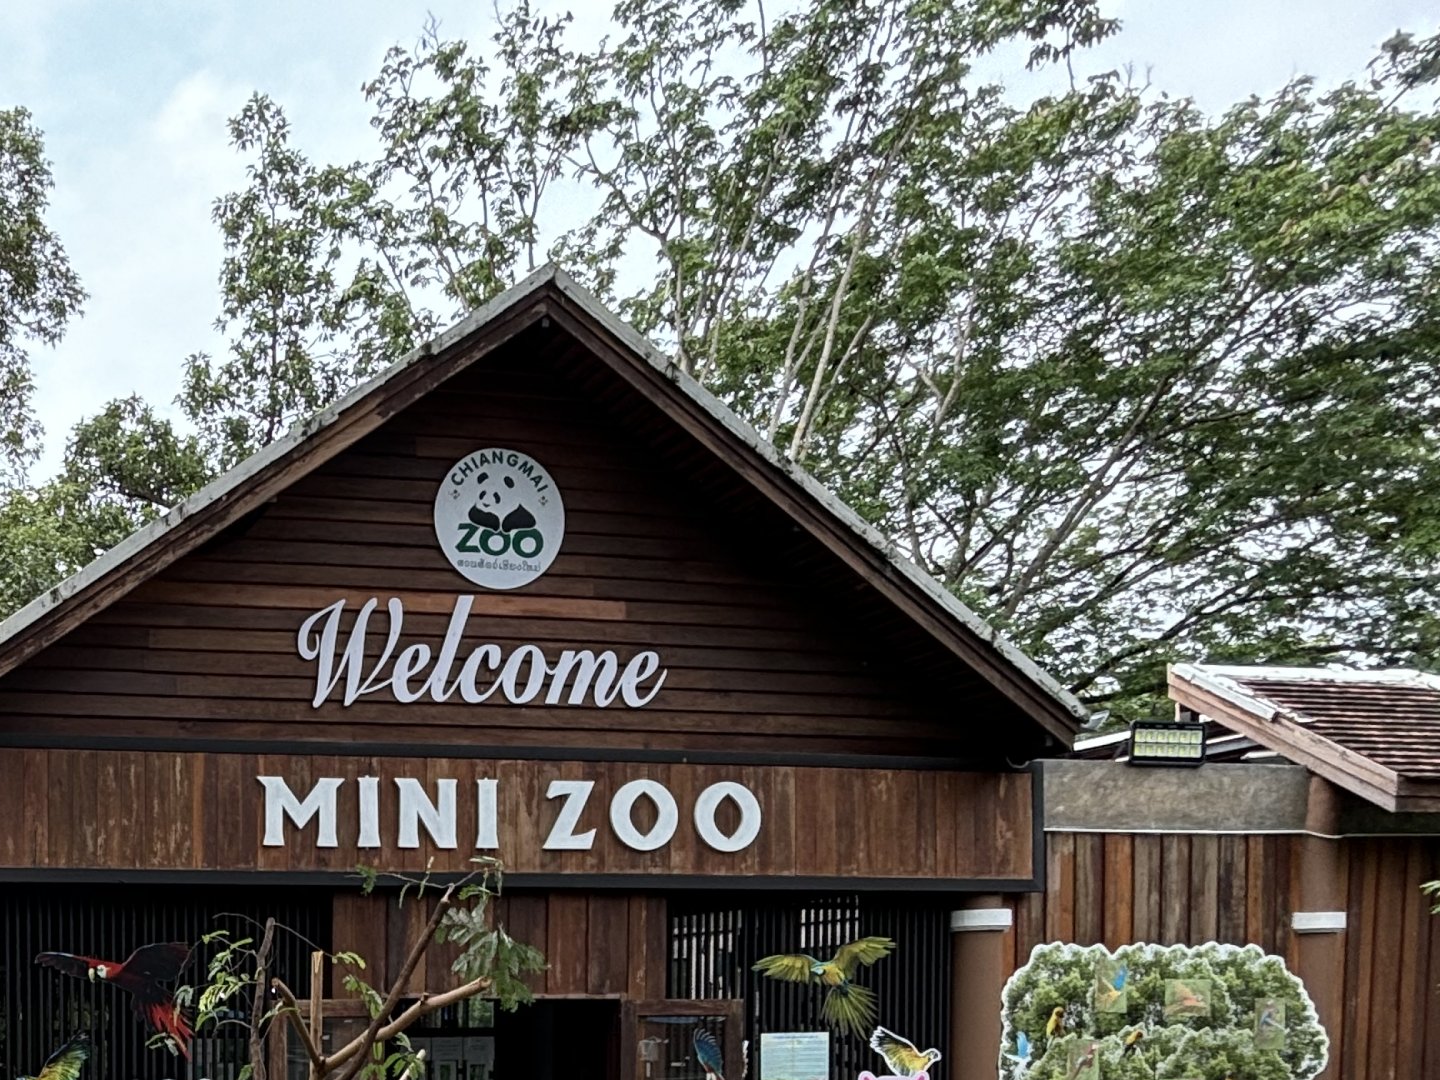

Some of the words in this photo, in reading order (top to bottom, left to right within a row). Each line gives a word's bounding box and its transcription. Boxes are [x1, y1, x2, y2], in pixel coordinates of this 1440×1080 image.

[455, 523, 544, 558] ZOO
[297, 595, 667, 709] Welcome
[257, 775, 499, 849] MINI
[542, 779, 761, 852] ZOO
